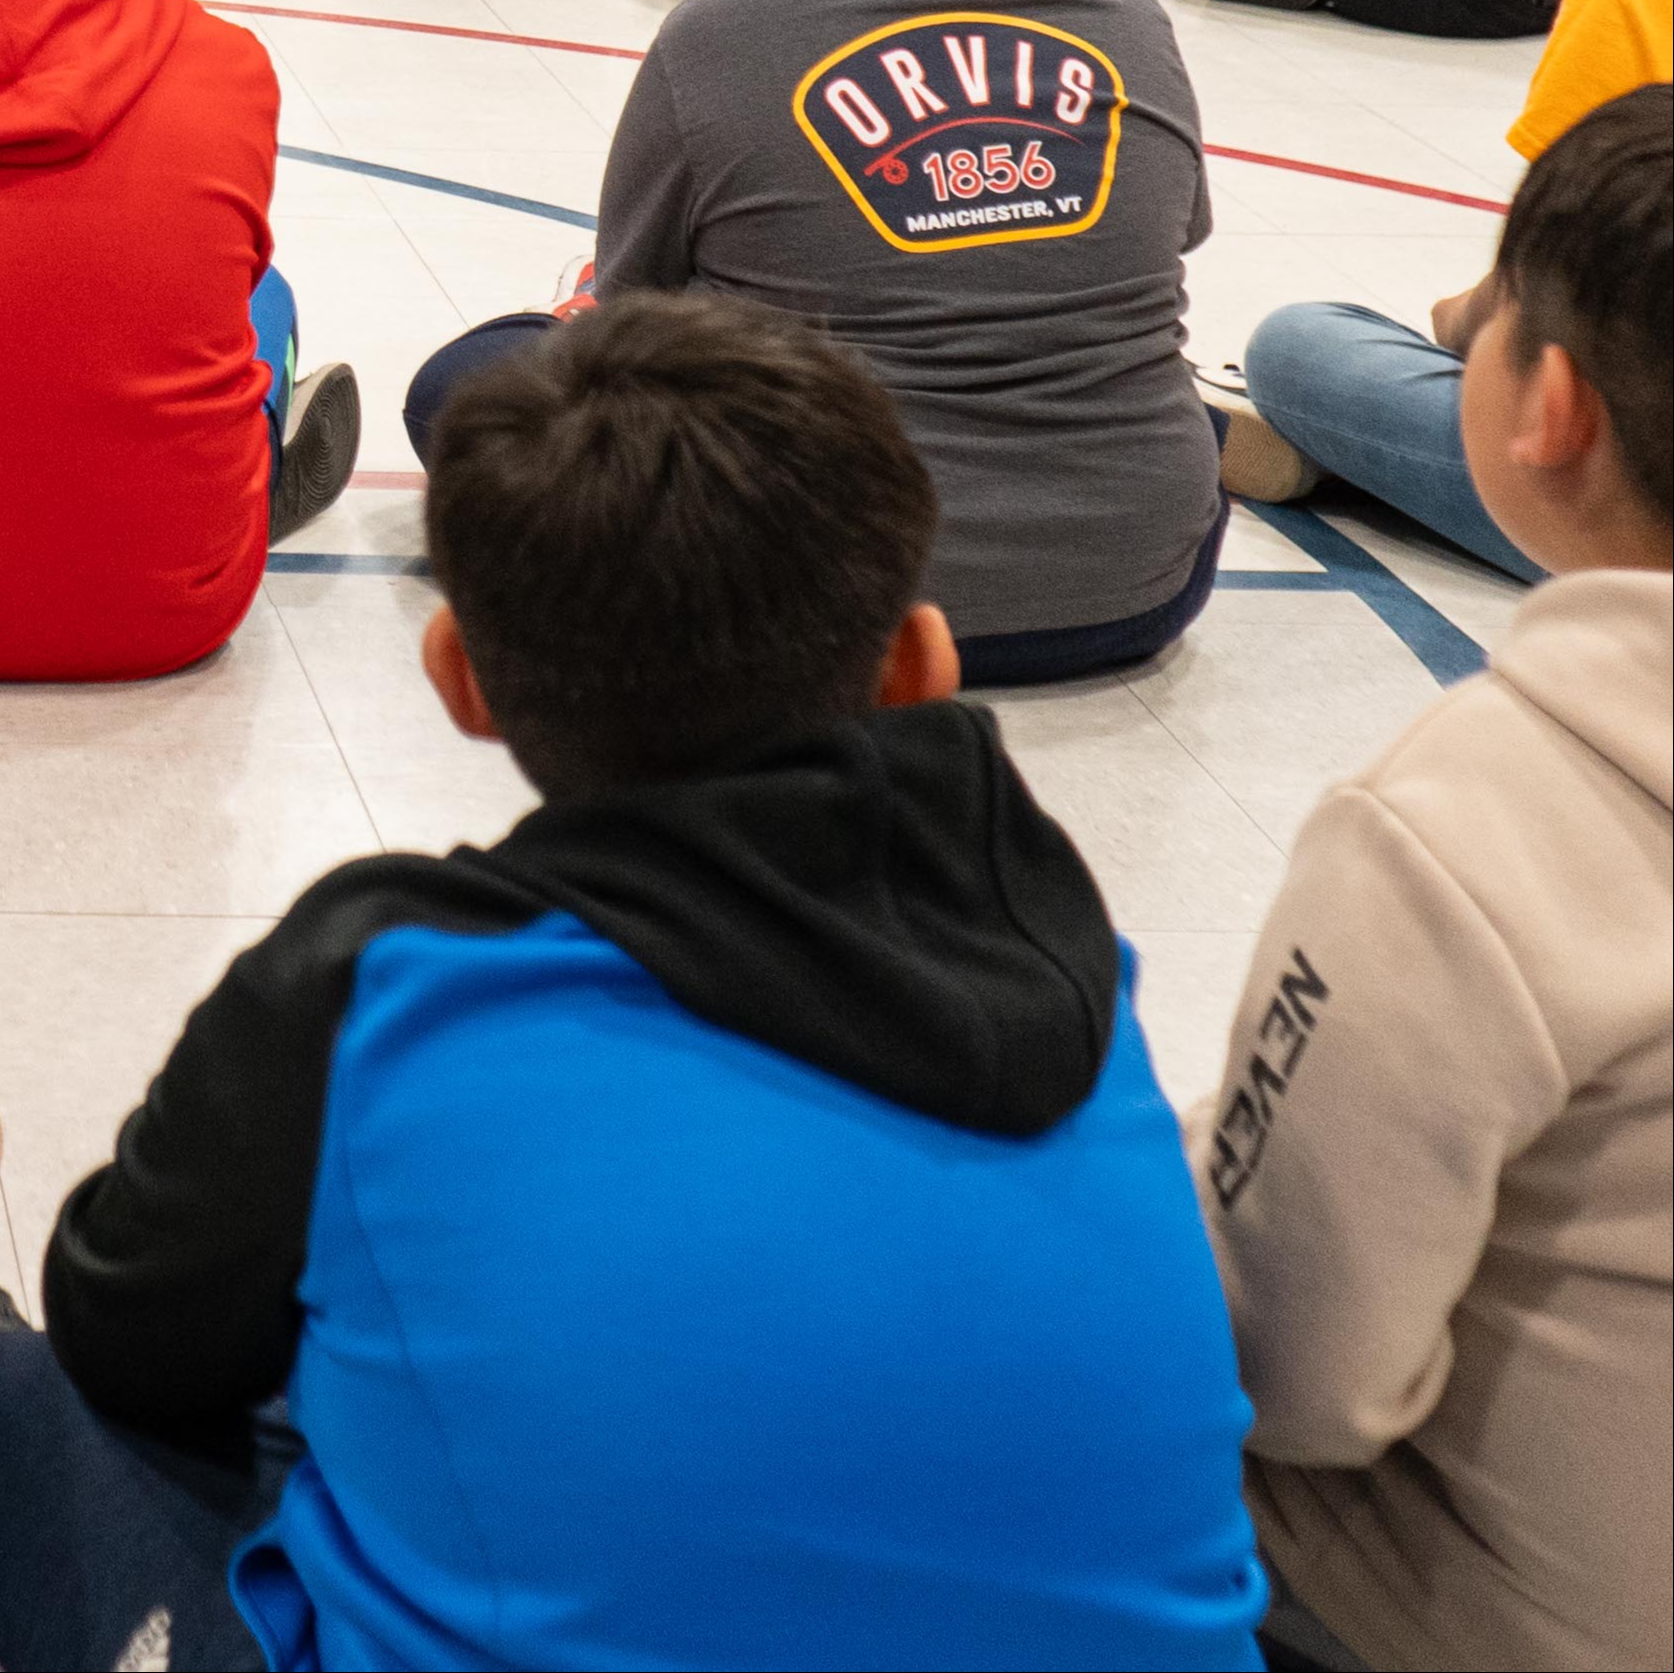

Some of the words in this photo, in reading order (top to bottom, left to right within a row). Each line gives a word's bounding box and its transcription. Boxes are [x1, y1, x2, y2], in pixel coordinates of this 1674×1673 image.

[823, 34, 1095, 148] ORVIS
[907, 200, 1055, 234] MANCHESTER,
[1055, 196, 1083, 215] VT
[921, 141, 1057, 203] 1856
[1208, 946, 1335, 1213] NEVER
